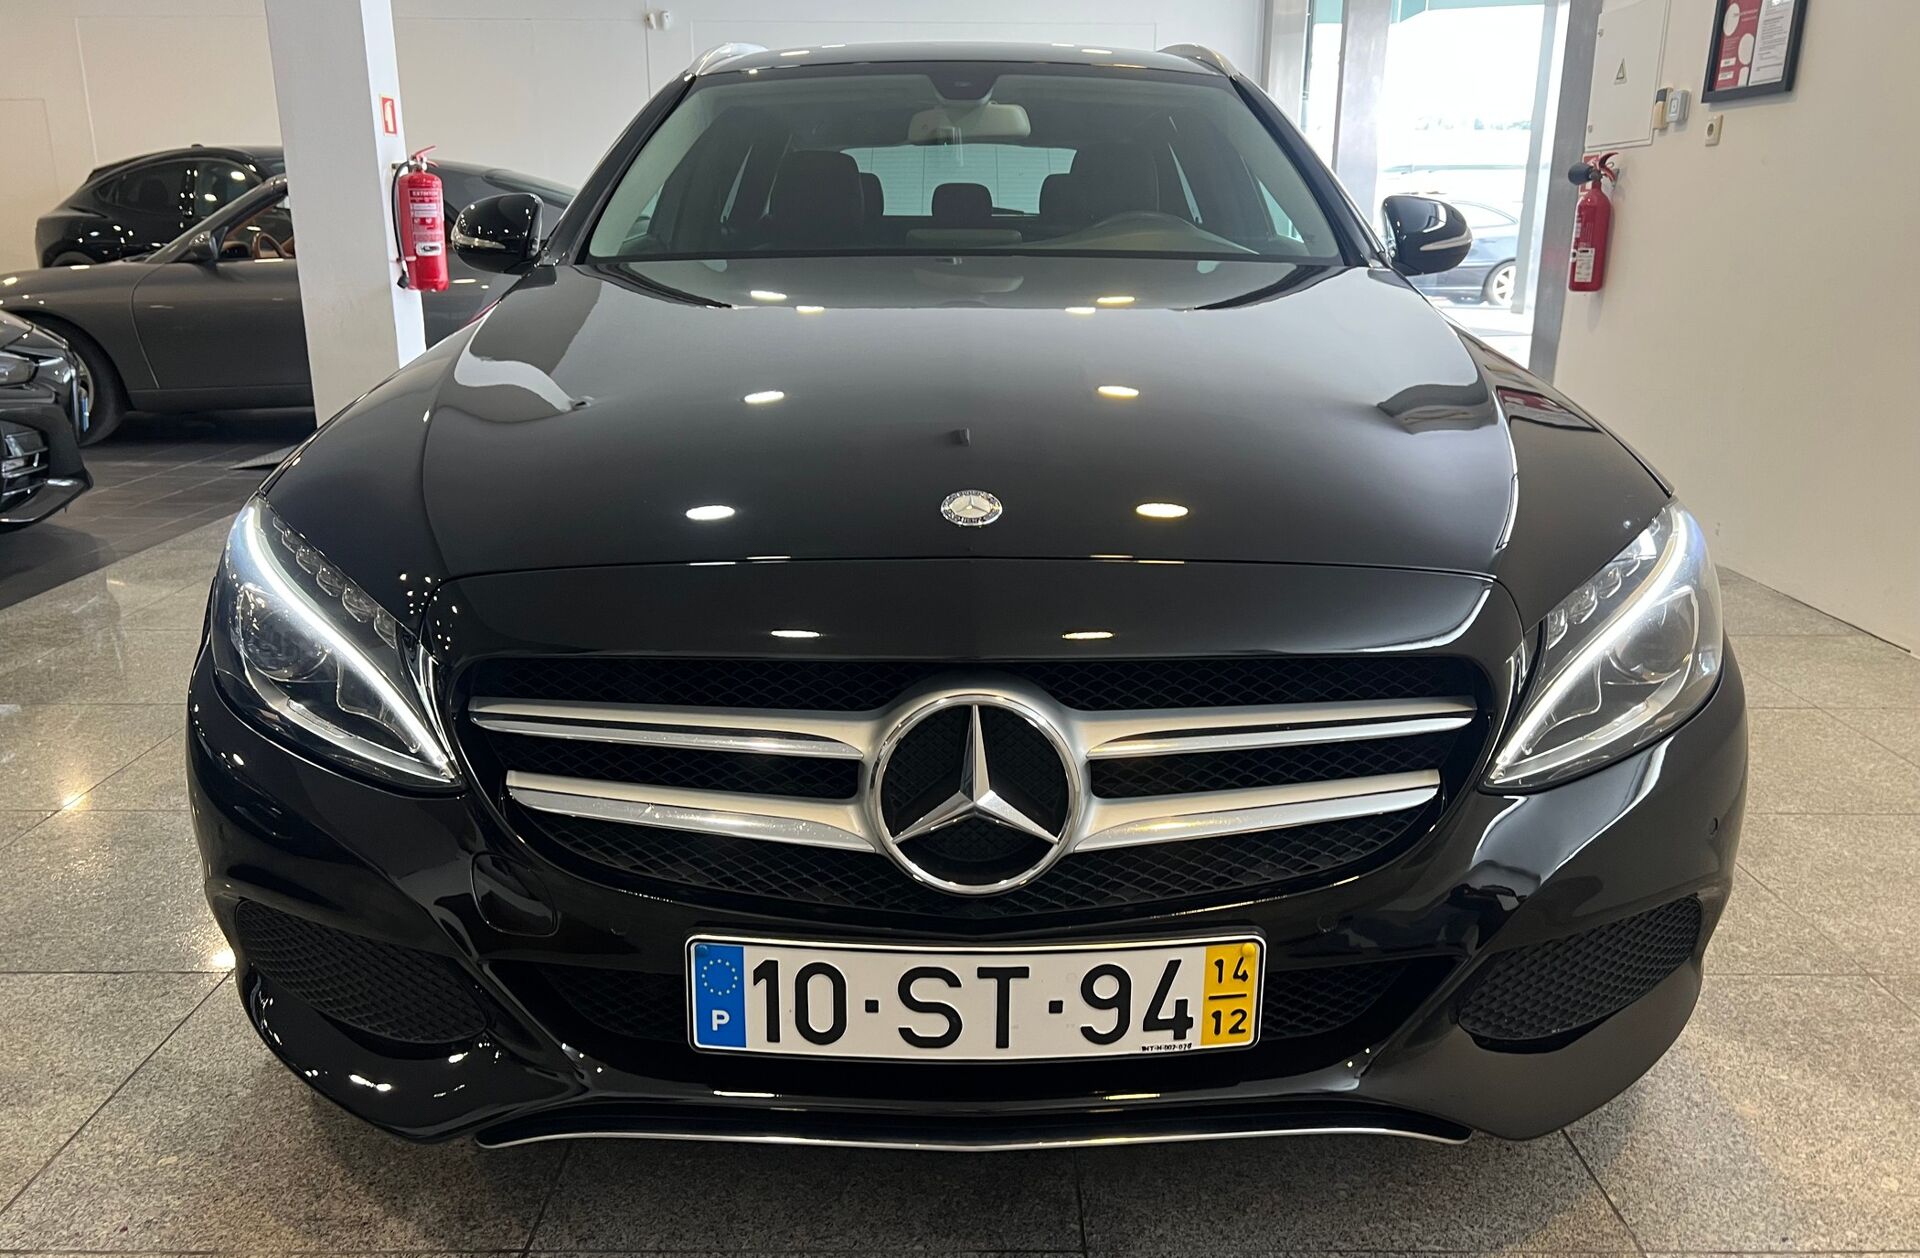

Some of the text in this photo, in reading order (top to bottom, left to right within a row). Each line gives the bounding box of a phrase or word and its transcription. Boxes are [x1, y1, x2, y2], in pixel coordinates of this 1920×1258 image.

[1213, 957, 1249, 984] 14
[711, 1009, 730, 1031] P
[1211, 1008, 1248, 1036] 12
